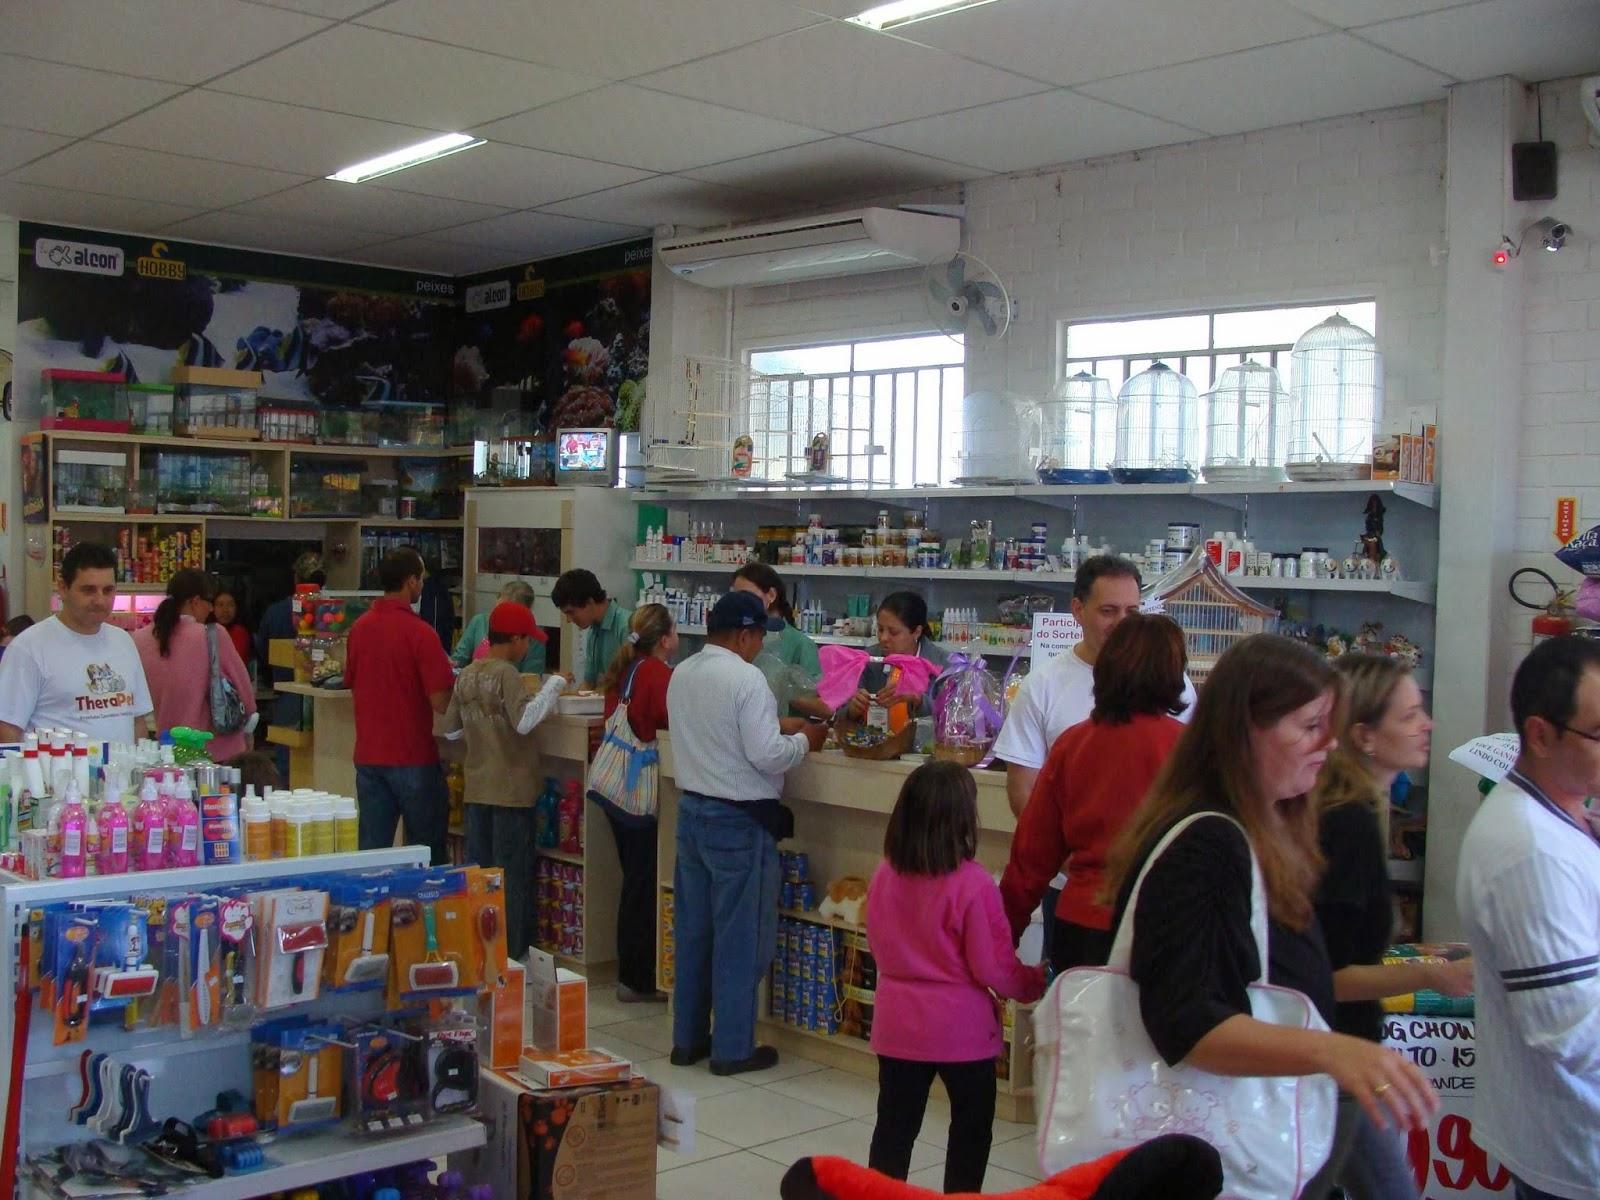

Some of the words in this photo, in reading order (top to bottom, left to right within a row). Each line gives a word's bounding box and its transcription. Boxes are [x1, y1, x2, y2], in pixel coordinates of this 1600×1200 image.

[74, 248, 117, 270] alcon
[140, 260, 185, 279] HOBBY
[416, 279, 455, 295] peixes
[1036, 630, 1050, 639] do
[1409, 1021, 1476, 1041] CHOW
